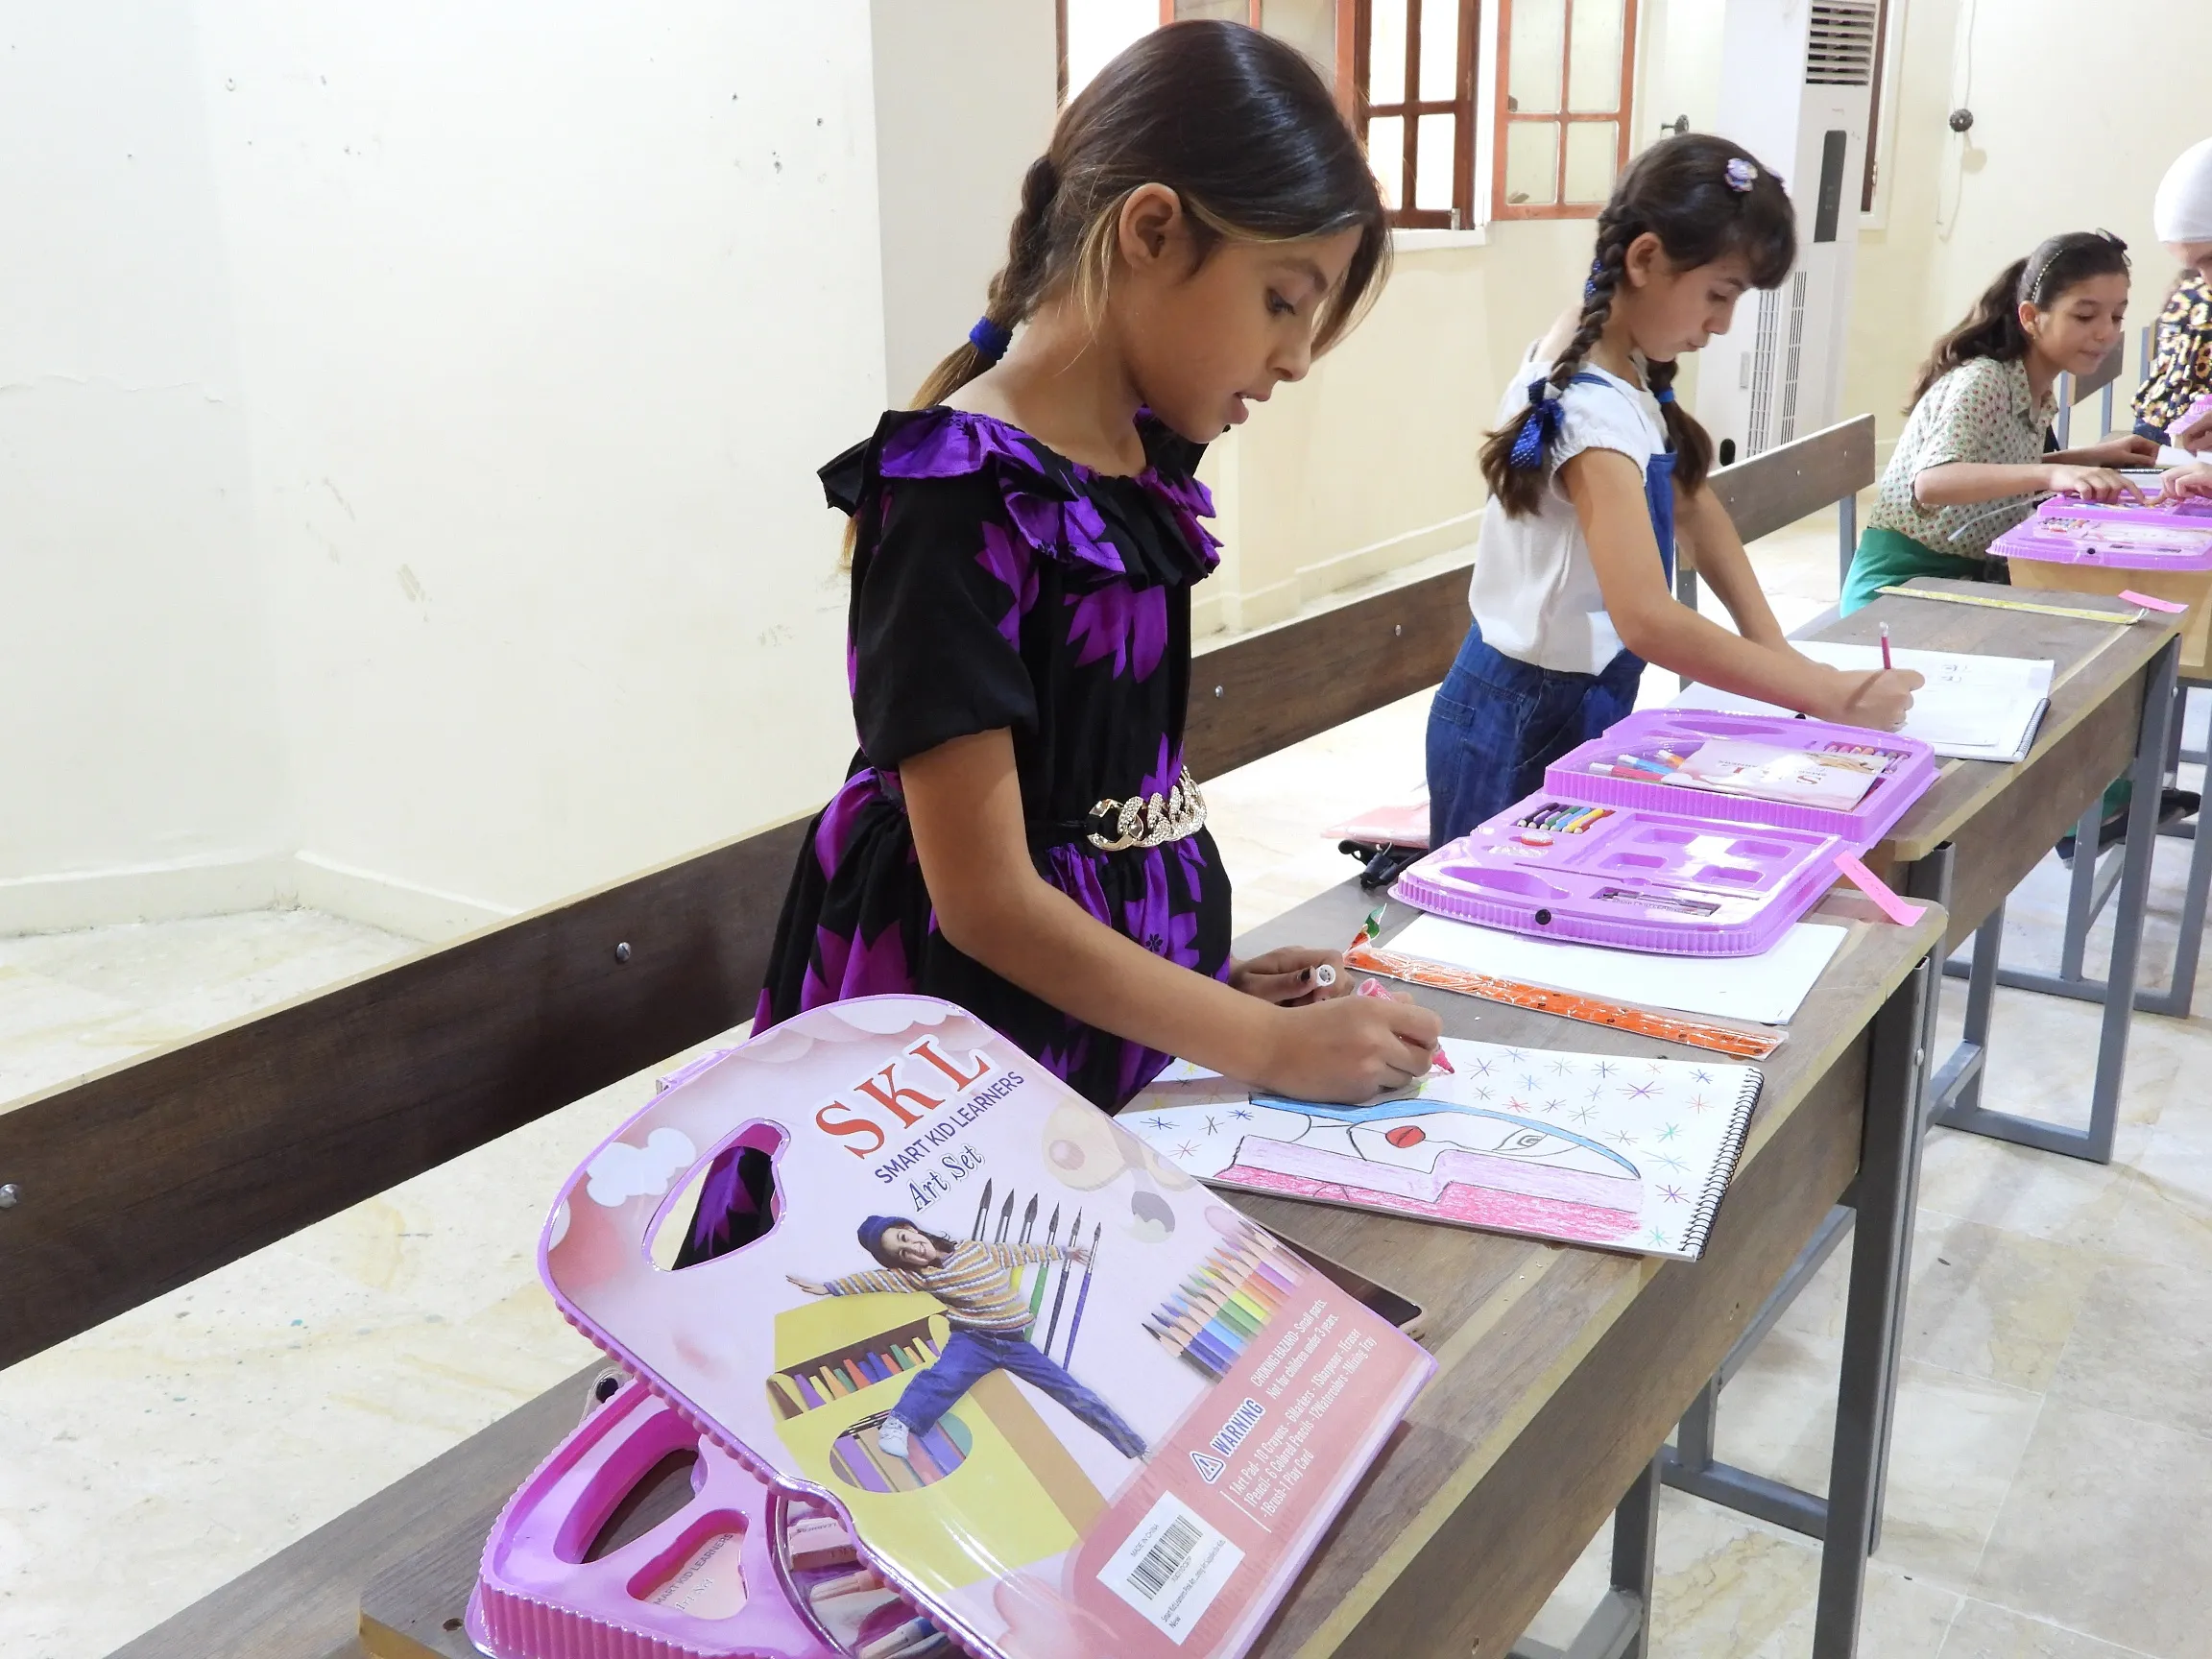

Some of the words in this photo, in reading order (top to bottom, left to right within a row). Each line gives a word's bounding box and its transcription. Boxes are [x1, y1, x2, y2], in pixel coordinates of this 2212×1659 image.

[815, 1040, 991, 1160] SKL
[875, 1139, 930, 1184] SMART
[925, 1122, 956, 1147] KID
[949, 1070, 1024, 1128] LEARNERS
[908, 1171, 949, 1212] Art
[941, 1144, 983, 1179] Set
[1250, 1355, 1279, 1385] CHOKING
[1293, 1311, 1313, 1333] Small
[1358, 1335, 1377, 1351] Tray
[1265, 1382, 1283, 1399] Not
[1275, 1374, 1289, 1387] for
[1285, 1351, 1308, 1377] children
[1304, 1334, 1320, 1353] under
[1313, 1327, 1326, 1336] 3
[1211, 1398, 1265, 1456] WARNING
[1254, 1449, 1268, 1463] 10
[1262, 1425, 1288, 1453] Crayons
[1288, 1420, 1313, 1446] Pencils
[1264, 1467, 1277, 1479] 6
[1270, 1442, 1296, 1471] Colored
[1283, 1466, 1303, 1485] Play
[1294, 1448, 1313, 1469] Card
[652, 1584, 680, 1605] MART
[1168, 1614, 1180, 1628] New
